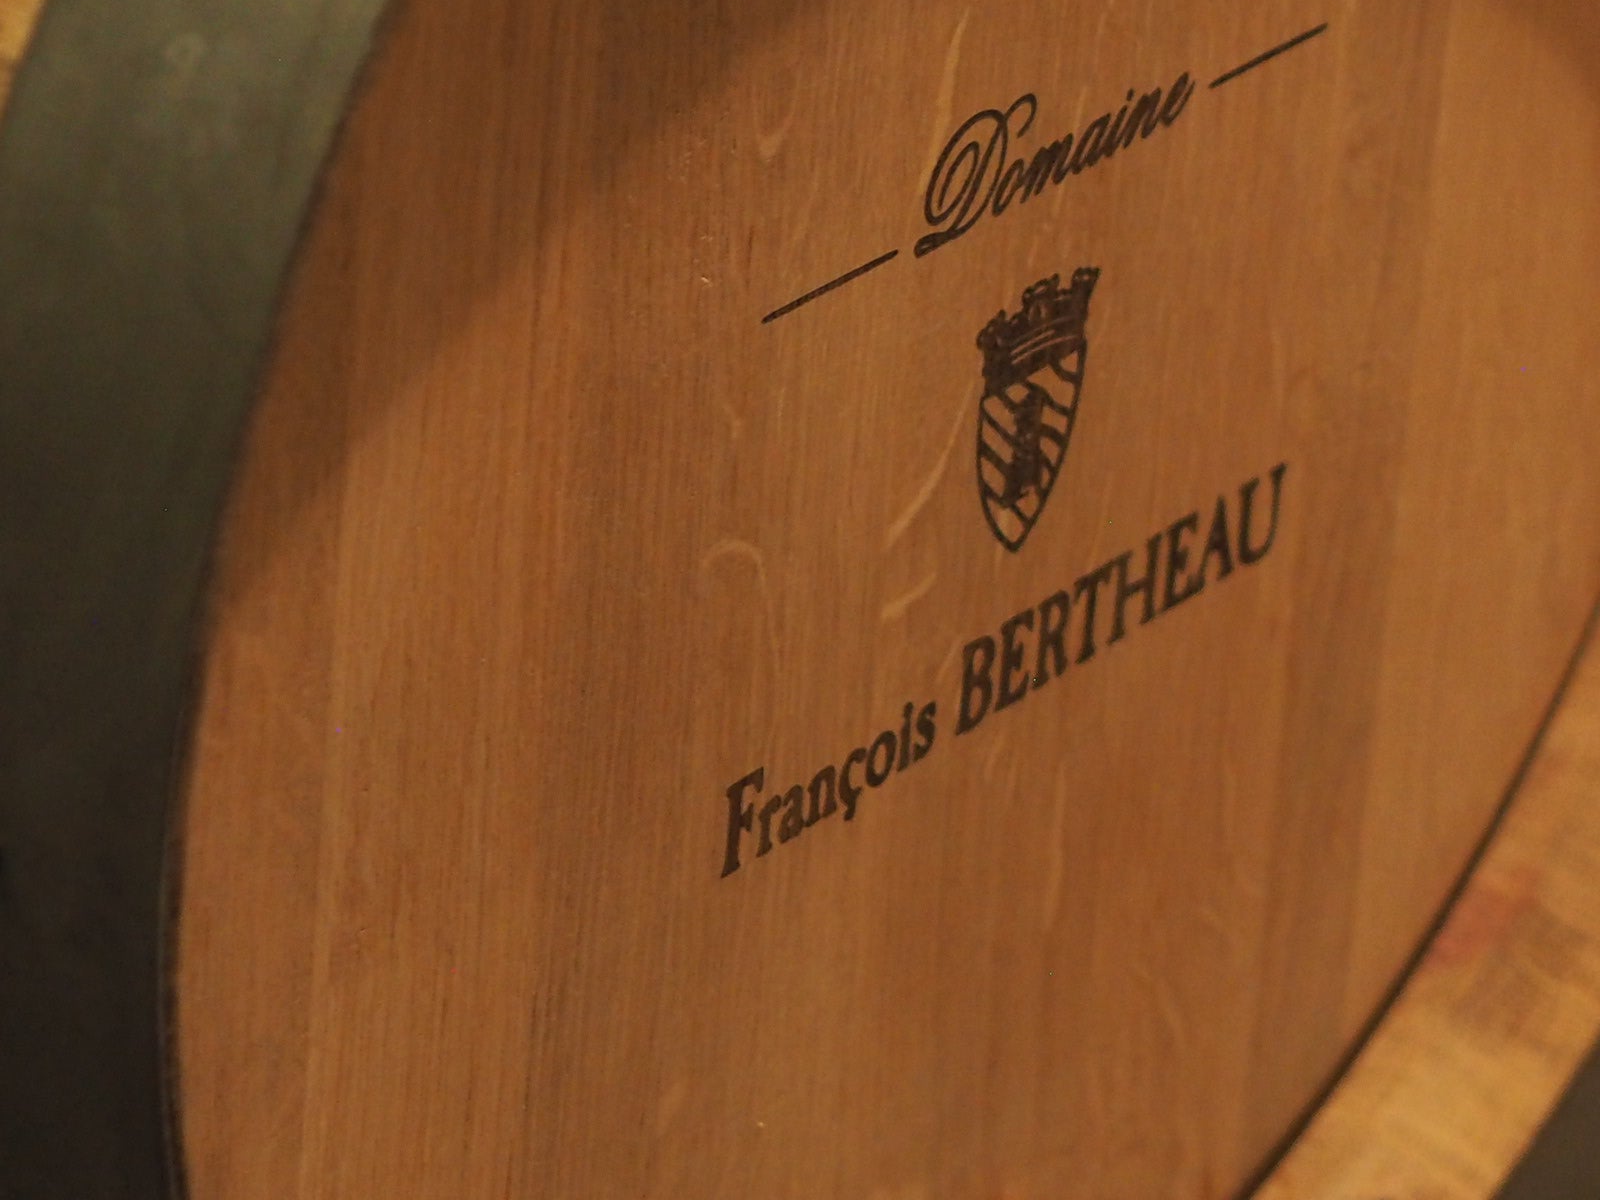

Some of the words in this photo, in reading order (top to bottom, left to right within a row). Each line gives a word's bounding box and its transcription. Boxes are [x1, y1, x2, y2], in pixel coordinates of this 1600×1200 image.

[914, 71, 1196, 259] Domaine
[720, 701, 937, 880] François
[955, 462, 1288, 736] BERTHEAU
